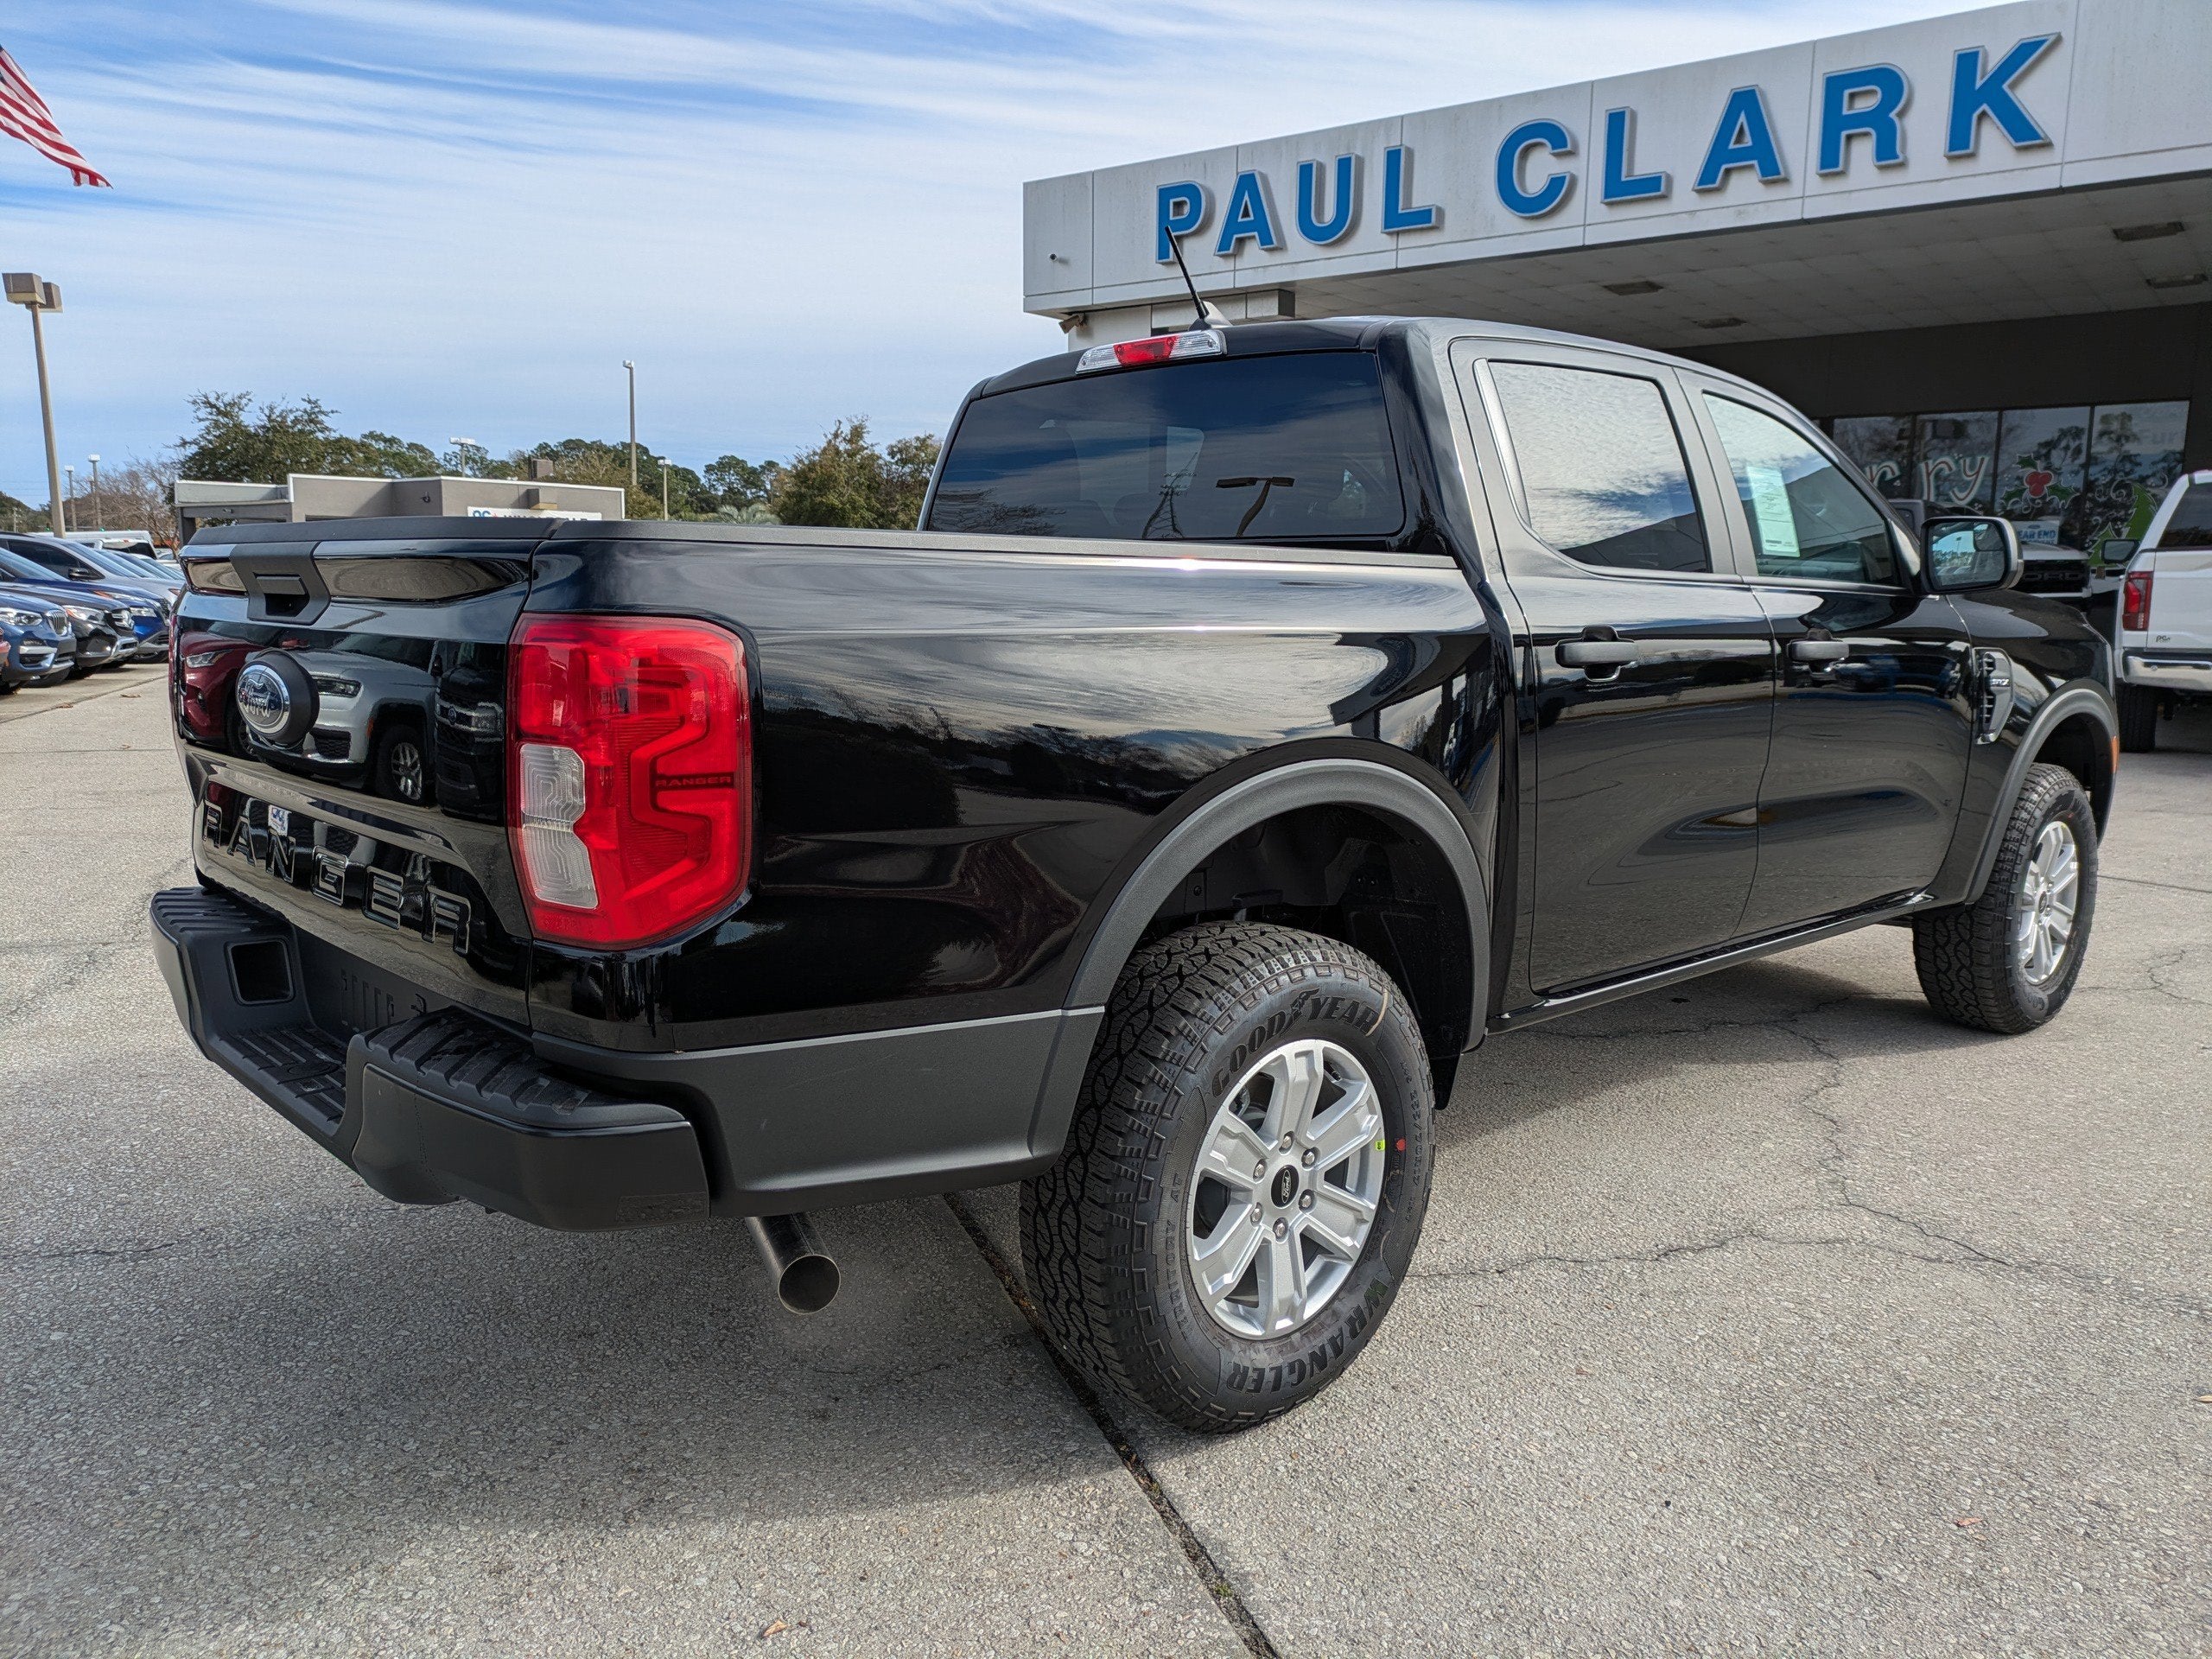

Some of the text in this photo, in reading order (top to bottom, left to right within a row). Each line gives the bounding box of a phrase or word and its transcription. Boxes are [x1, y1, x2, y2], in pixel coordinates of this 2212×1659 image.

[1155, 32, 2062, 264] PAUL CLARK
[2037, 529, 2056, 538] END
[244, 678, 271, 718] Ford
[656, 776, 732, 787] RANGER
[203, 798, 472, 957] RANGER
[1212, 988, 1381, 1098] GOODYEAR
[1171, 1173, 1182, 1203] AT
[1227, 1277, 1389, 1394] WRANGLER
